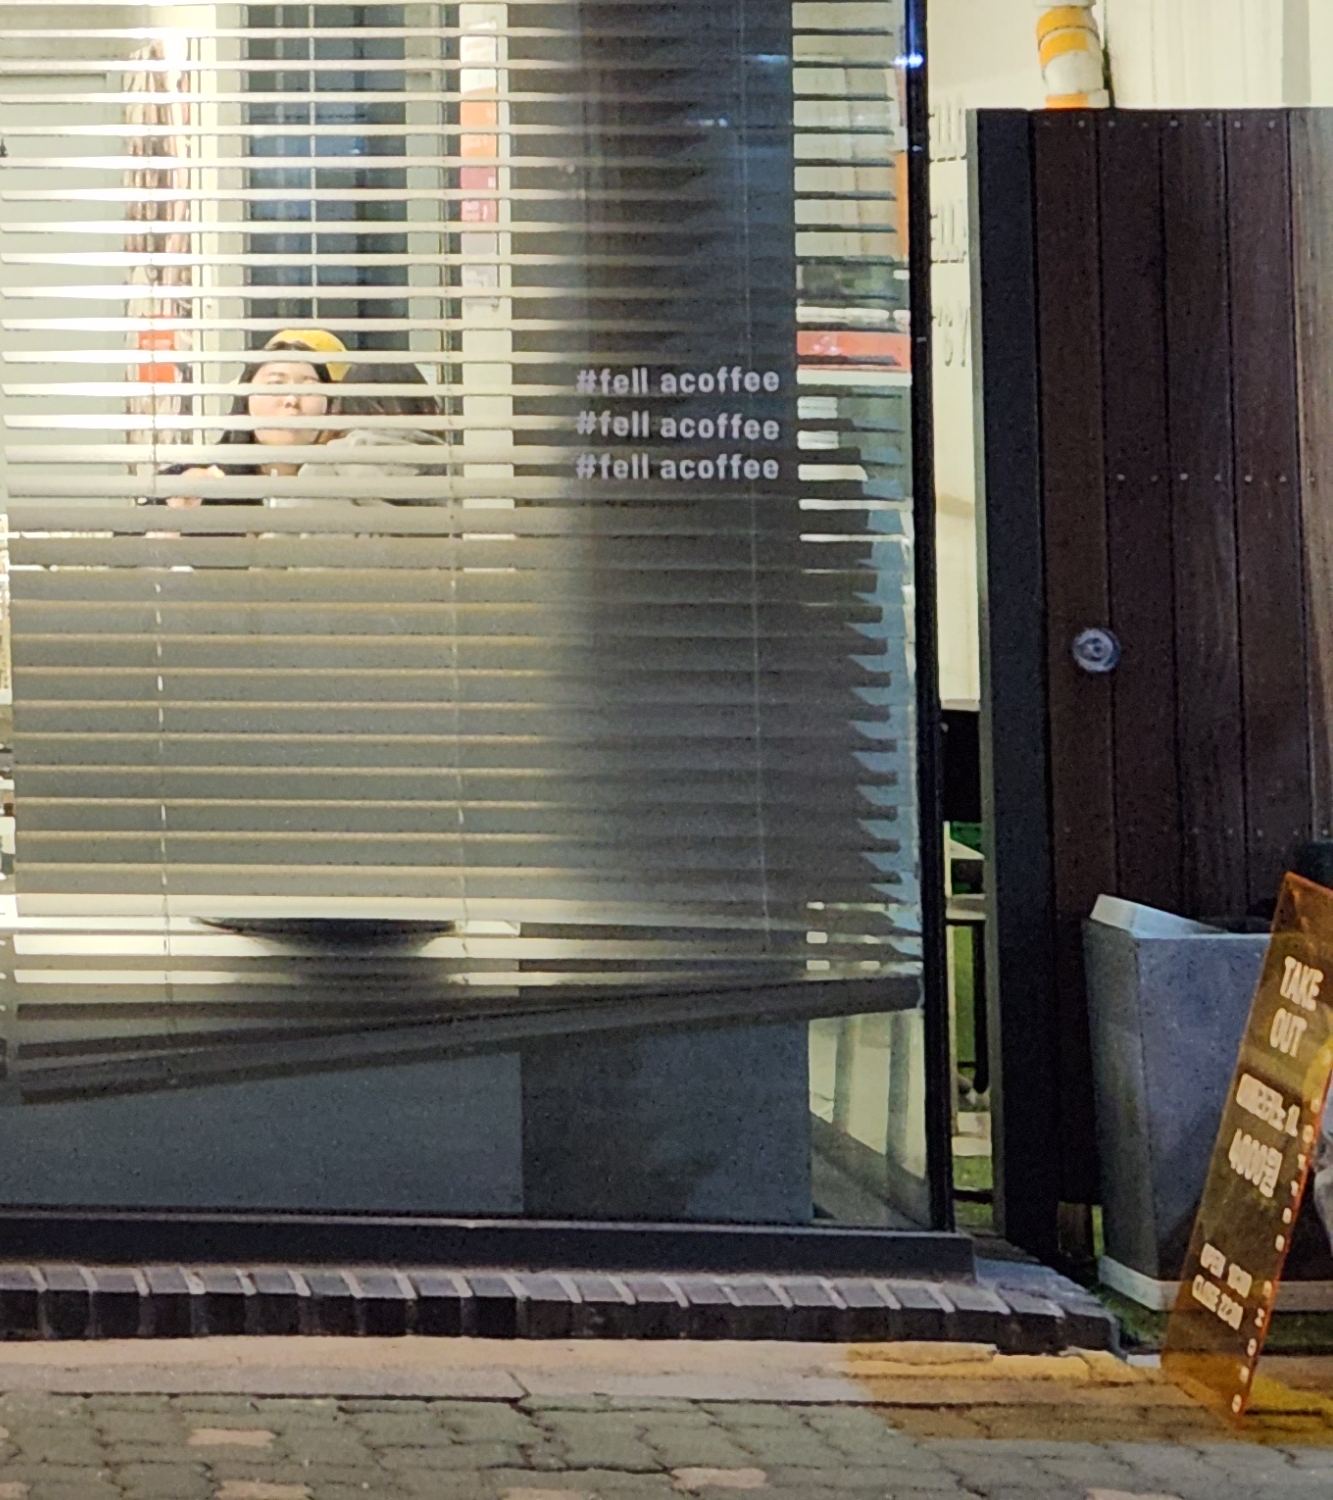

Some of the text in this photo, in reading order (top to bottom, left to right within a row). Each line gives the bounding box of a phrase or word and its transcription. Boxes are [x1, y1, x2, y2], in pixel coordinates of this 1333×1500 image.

[576, 367, 780, 395] #fell acoffee
[576, 410, 780, 441] #fell acoffee
[576, 452, 780, 480] #fell acoffee
[1279, 955, 1324, 1012] TAKE
[1269, 1007, 1308, 1058] OUT
